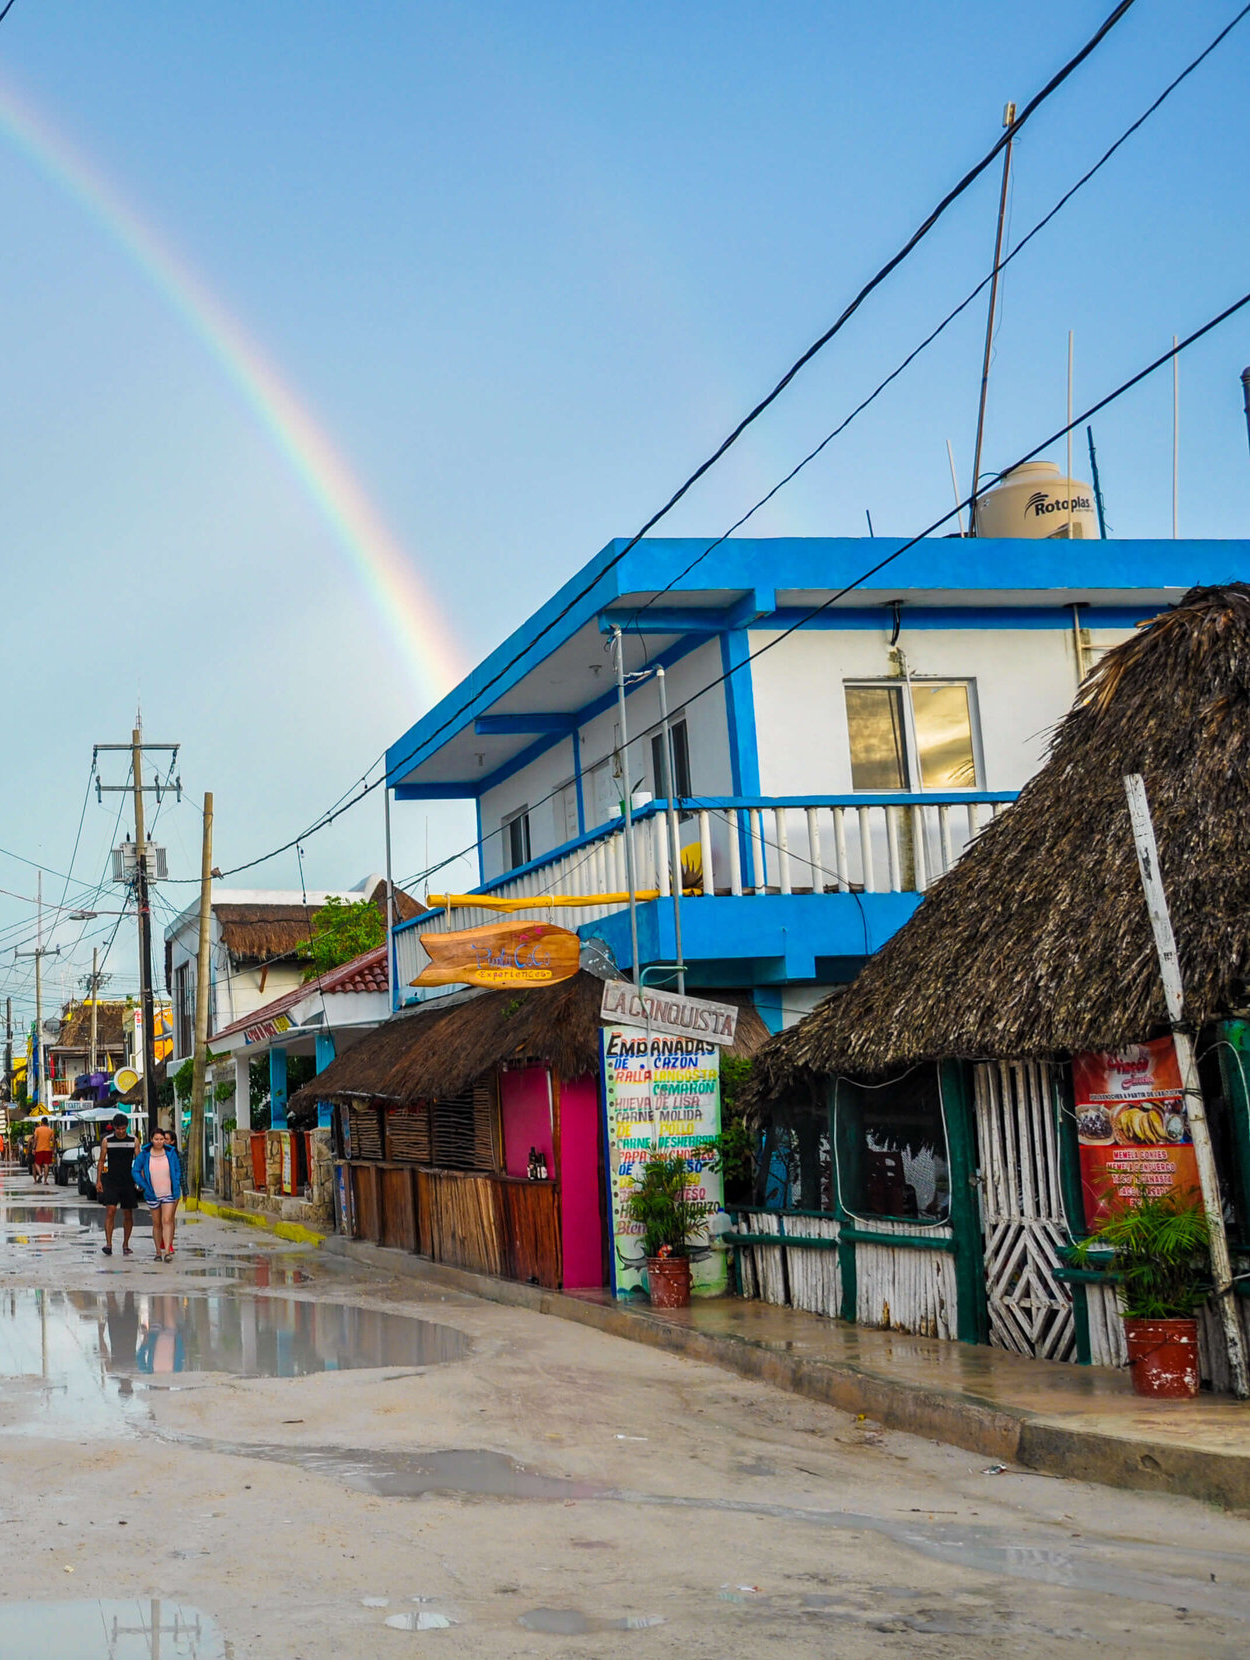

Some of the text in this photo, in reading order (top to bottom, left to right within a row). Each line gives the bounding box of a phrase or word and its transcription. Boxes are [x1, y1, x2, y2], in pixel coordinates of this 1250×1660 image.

[1034, 496, 1090, 517] Rotoplas
[602, 988, 733, 1037] LA CONQUISTA
[614, 1058, 630, 1070] DE
[653, 1069, 718, 1082] LANGOSTA
[615, 1096, 701, 1111] HUEVA DE LISA
[616, 1110, 703, 1122] CARNE MOLIDA
[616, 1123, 695, 1138] DE POLLO
[617, 1137, 651, 1149] CARNE
[670, 1149, 716, 1161] CHOZO
[618, 1162, 633, 1176] DE
